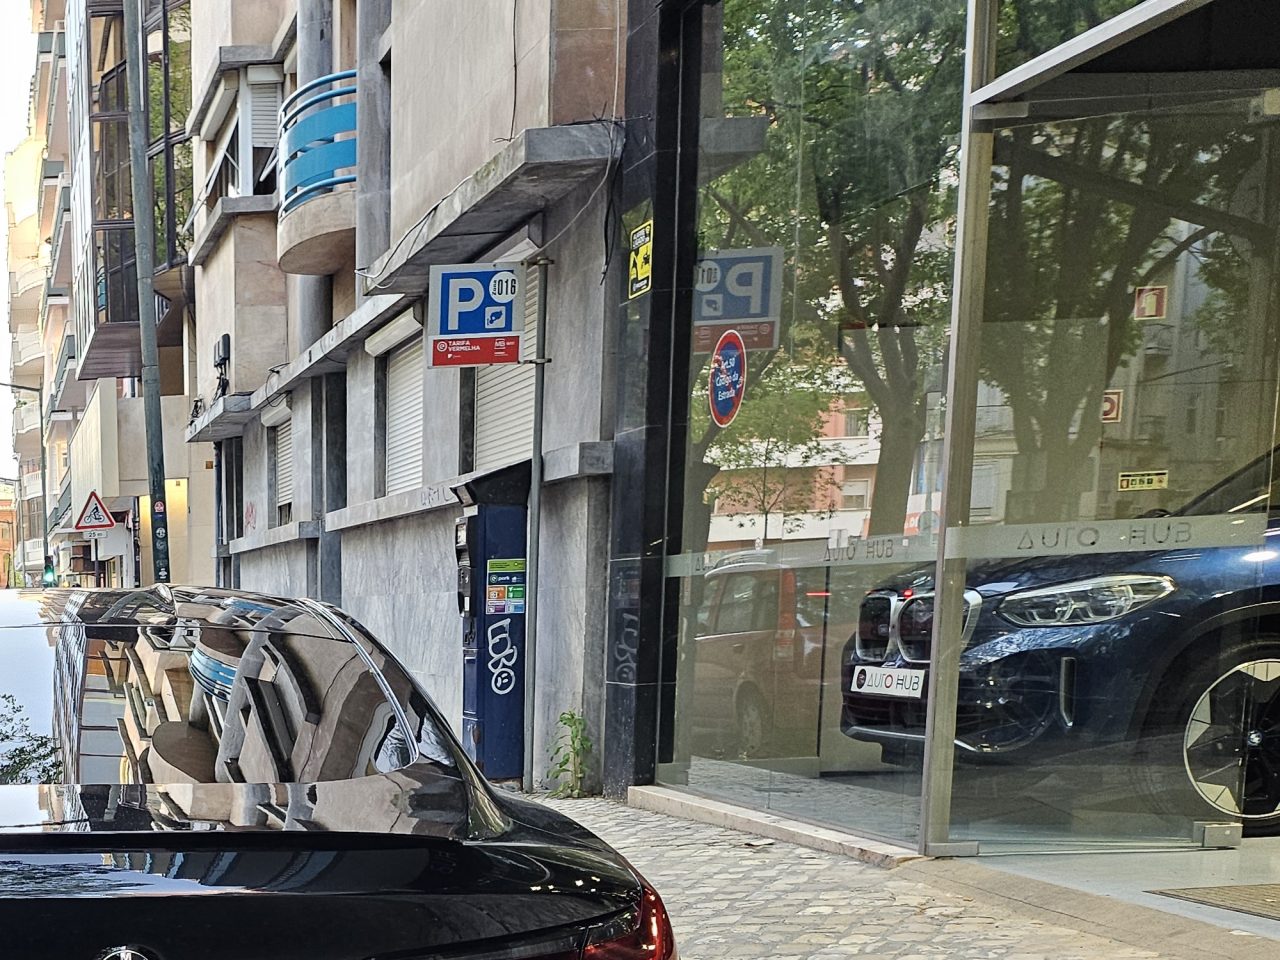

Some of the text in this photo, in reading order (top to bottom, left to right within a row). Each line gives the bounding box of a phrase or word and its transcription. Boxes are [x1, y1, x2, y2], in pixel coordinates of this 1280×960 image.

[497, 278, 517, 296] 016
[448, 277, 485, 331] P
[1017, 521, 1192, 549] AUTO HUB
[866, 538, 893, 558] HUB
[867, 672, 920, 691] AUTO HUB
